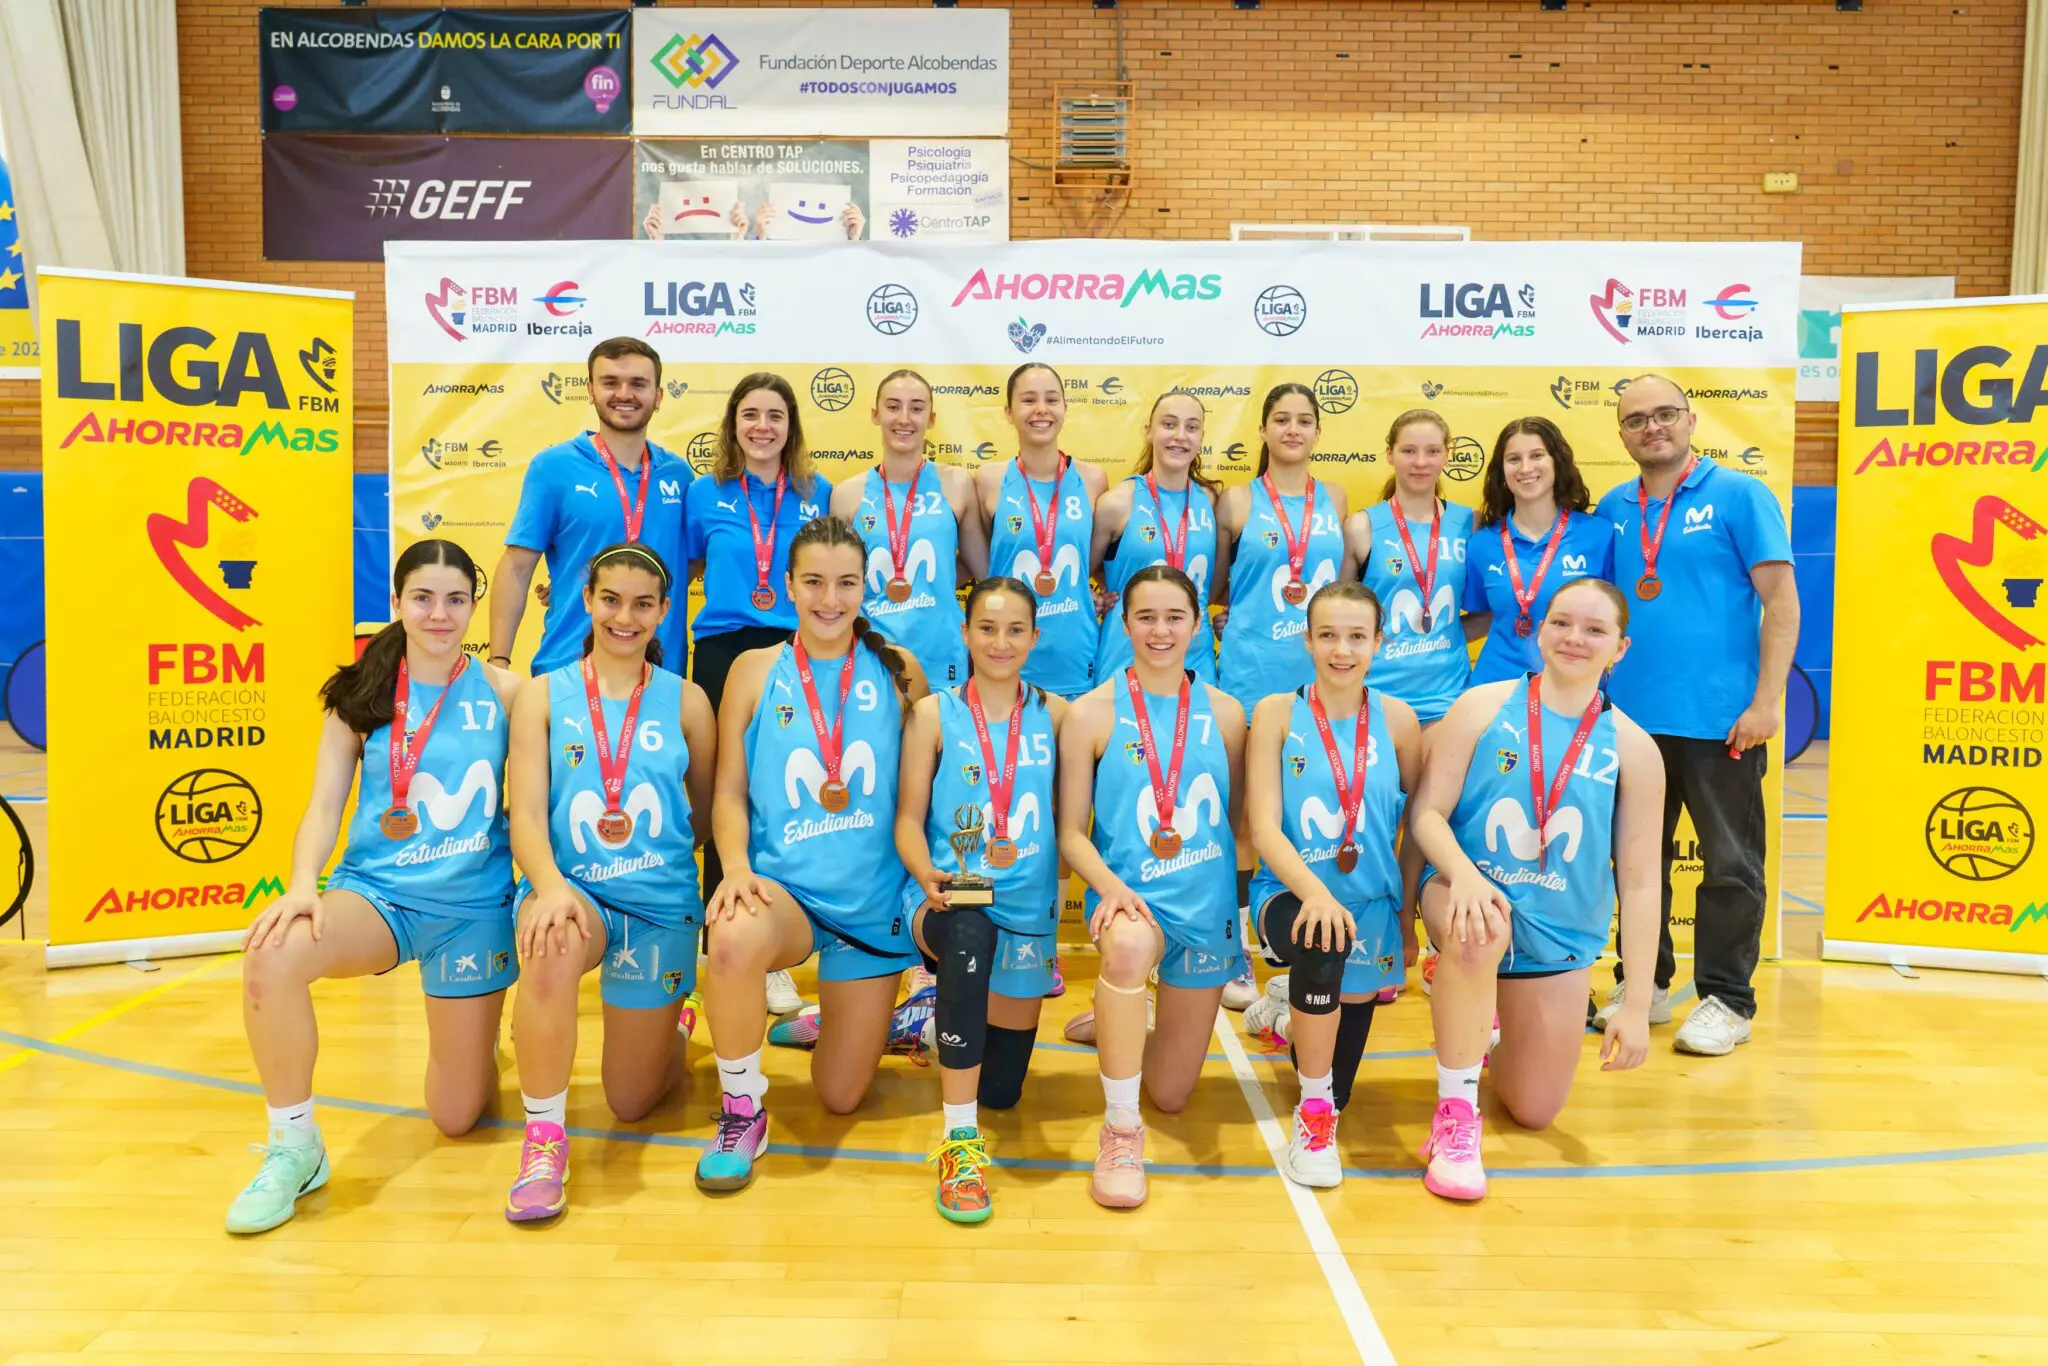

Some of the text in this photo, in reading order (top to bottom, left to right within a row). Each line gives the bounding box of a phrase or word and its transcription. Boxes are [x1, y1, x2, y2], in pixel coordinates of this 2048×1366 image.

[271, 32, 621, 49] EN ALCOBENDAS DAMOS LA CARA POR TI
[759, 54, 997, 74] Fundación Deporte Alcobendas
[592, 74, 614, 90] fin
[800, 82, 957, 96] #TODOSCONJUGAMOS
[653, 95, 737, 110] FUNDAL
[700, 145, 803, 158] En CENTRO TAP
[908, 146, 972, 160] Psicología
[641, 161, 864, 177] nos gusta hablar de SOLUCIONES.
[908, 159, 972, 173] Psiquiatría
[890, 172, 989, 186] Psicopedagogía
[907, 184, 972, 196] Formación
[410, 180, 532, 220] GEFF
[471, 287, 518, 305] FBM
[644, 282, 736, 316] LIGA
[1420, 283, 1514, 318] LIGA
[1639, 289, 1687, 307] FBM
[874, 301, 904, 314] LIGA
[1261, 303, 1293, 315] LIGA
[472, 323, 517, 333] MADRID
[527, 321, 593, 337] Ibercaja
[1637, 326, 1686, 336] MADRID
[1695, 326, 1763, 342] Ibercaja
[12, 341, 40, 356] 202
[1046, 335, 1165, 347] #AlimentandoElFuturo
[56, 319, 291, 410] LIGA
[565, 377, 589, 387] FBM
[817, 382, 843, 393] LIGA
[931, 385, 1000, 397] HORRaMas
[1064, 379, 1089, 389] FBM
[1319, 385, 1346, 395] LIGA
[1575, 381, 1600, 391] FBM
[299, 395, 339, 413] FBM
[1092, 397, 1127, 406] Ibercaja
[445, 442, 468, 452] FBM
[693, 447, 713, 458] LIG
[939, 444, 963, 454] FBM
[1703, 449, 1728, 458] FBM
[472, 459, 506, 469] Ibercaja
[1854, 437, 2048, 476] AHORRa
[1217, 464, 1251, 472] Ibercaja
[912, 491, 943, 516] 32
[1065, 495, 1083, 520] 8
[1188, 508, 1213, 532] 14
[1311, 514, 1341, 538] 24
[1438, 536, 1467, 563] 16
[1036, 597, 1079, 619] diantes
[148, 643, 265, 685] FBM
[1925, 660, 2046, 704] FBM
[148, 688, 266, 707] FEDERACIÓN
[855, 679, 878, 712] 9
[148, 708, 266, 725] BALONCESTO
[458, 700, 498, 731] 17
[1923, 707, 2045, 725] FEDERACIÓN
[639, 720, 664, 752] 6
[1176, 707, 1187, 747] BALONCESTO
[1192, 714, 1212, 745] 7
[1923, 725, 2044, 743] BALONCESTO
[149, 726, 266, 750] MADRID
[598, 731, 607, 758] MADRID
[619, 716, 635, 758] BALONCESTO
[1140, 718, 1155, 759] BALONCESTO
[1018, 733, 1051, 767] 15
[1532, 743, 1541, 772] MADRID
[1923, 744, 2043, 768] MADRID
[392, 742, 401, 785] BALONCES
[1357, 746, 1365, 773] MADRID
[1573, 743, 1620, 786] 12
[1330, 749, 1346, 791] BALONCESTO
[1555, 764, 1570, 790] MADRID
[1167, 770, 1178, 797] MADRID
[171, 801, 233, 825] LIGA
[784, 808, 875, 846] Estudiantes
[1940, 818, 2005, 843] LIGA
[84, 875, 287, 923] AHORRaM
[1065, 901, 1083, 910] BM
[1856, 893, 2048, 932] AHORRaM
[1313, 993, 1331, 1006] NBA
